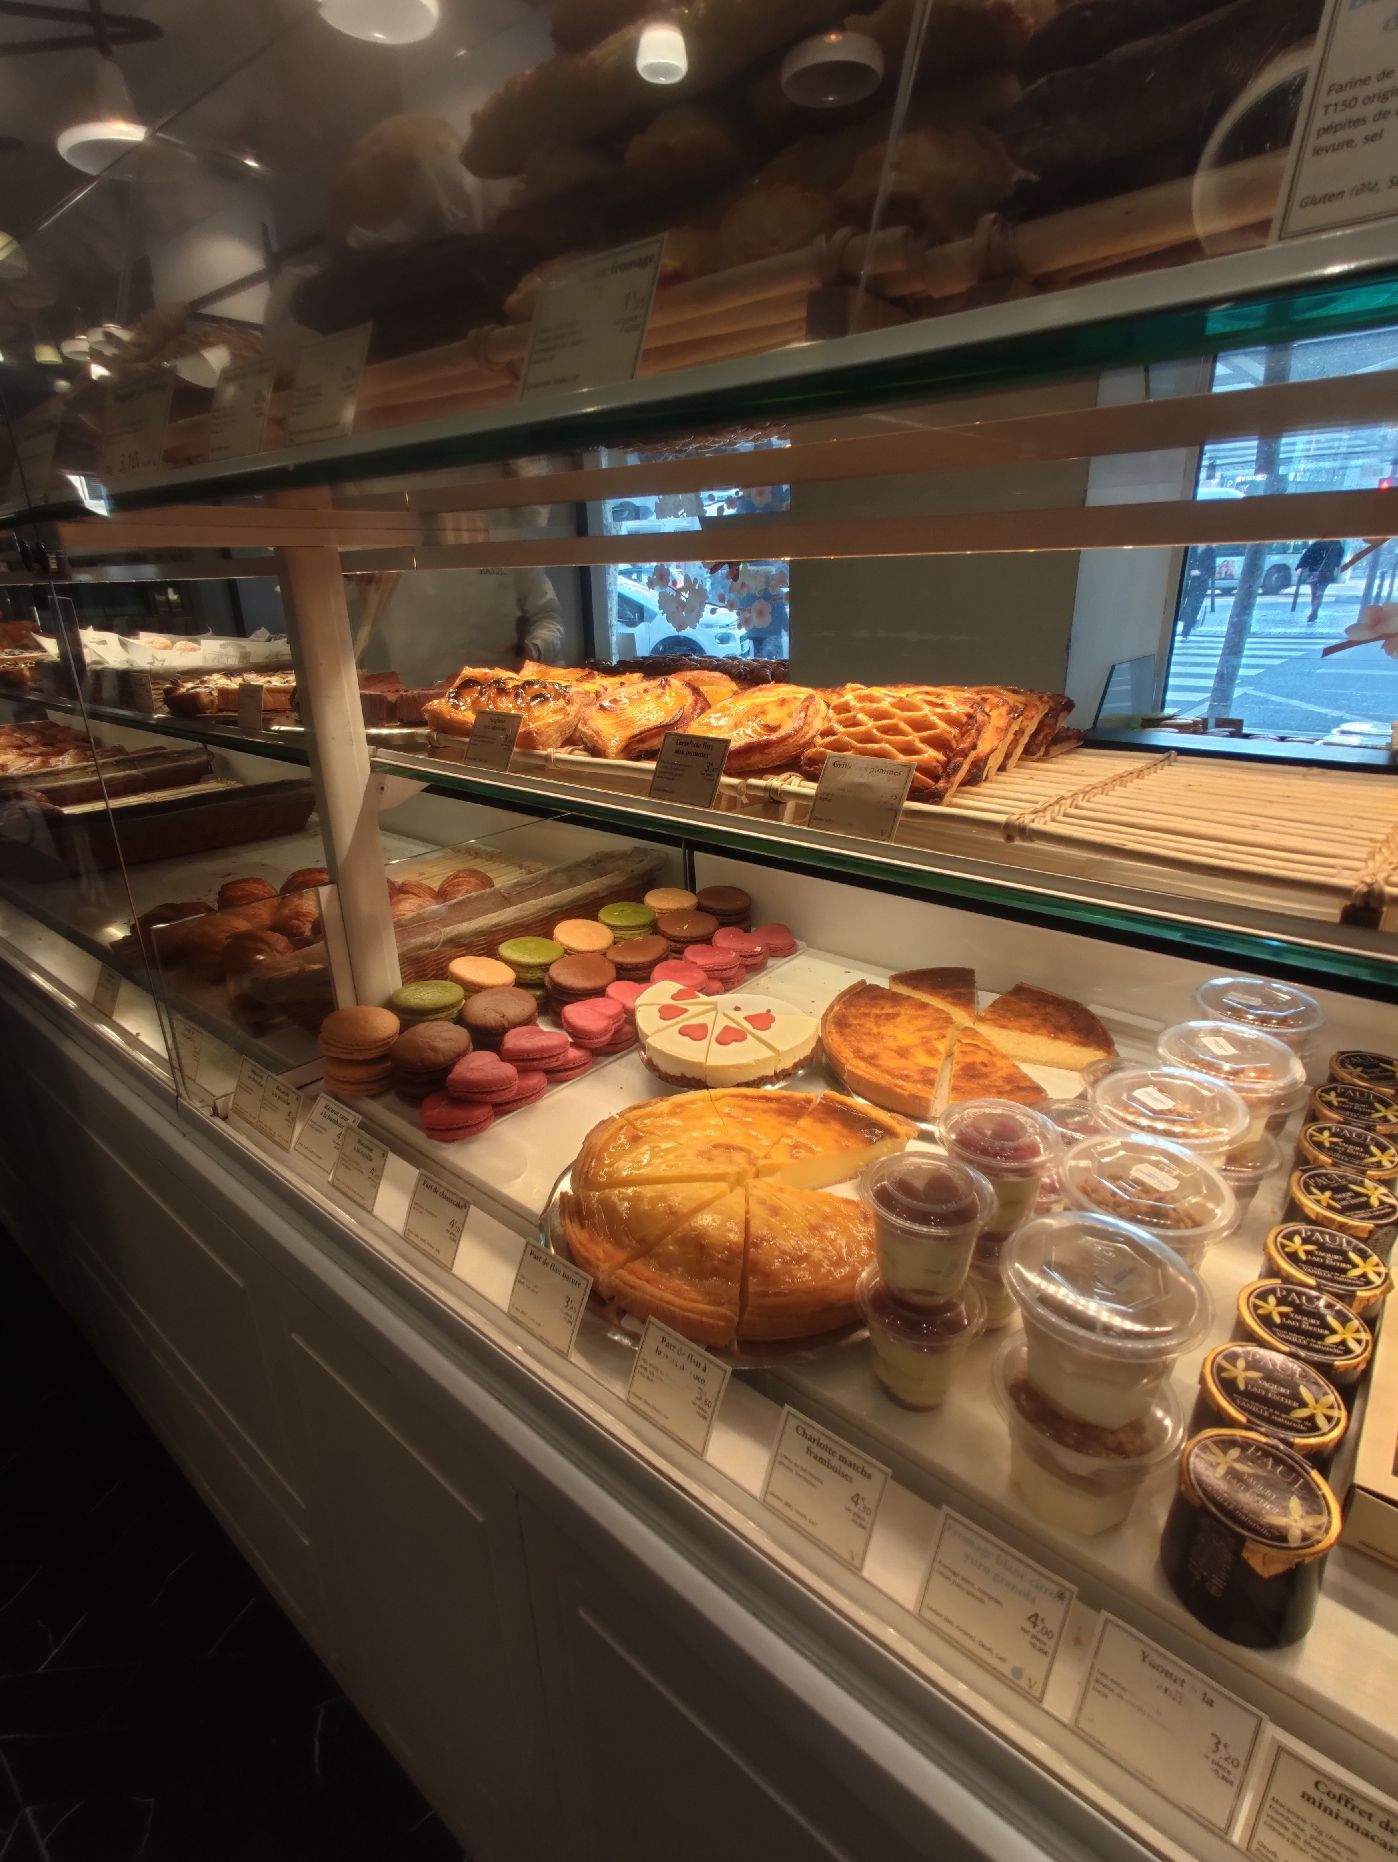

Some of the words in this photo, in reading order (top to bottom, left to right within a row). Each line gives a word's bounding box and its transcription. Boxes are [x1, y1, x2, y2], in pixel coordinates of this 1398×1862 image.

[1326, 75, 1371, 96] Farine
[1376, 68, 1394, 83] de
[1323, 96, 1358, 116] T150
[1315, 116, 1368, 140] pépites
[1373, 110, 1391, 125] de
[1363, 128, 1384, 145] sel
[1332, 1126, 1372, 1143] PAUL
[1300, 1228, 1353, 1250] PAUL
[1248, 1352, 1305, 1378] PAUL
[1258, 1379, 1290, 1395] YAOURT
[1268, 1392, 1299, 1407] ENTIER
[1236, 1399, 1270, 1417] VANILLE
[794, 1422, 837, 1458] Charlotte
[837, 1450, 873, 1481] matcha
[804, 1443, 855, 1484] framboises
[1247, 1445, 1304, 1490] PAUL
[1138, 1648, 1186, 1690] Yaourt
[1313, 1776, 1375, 1824] Coffret
[1378, 1815, 1398, 1838] de
